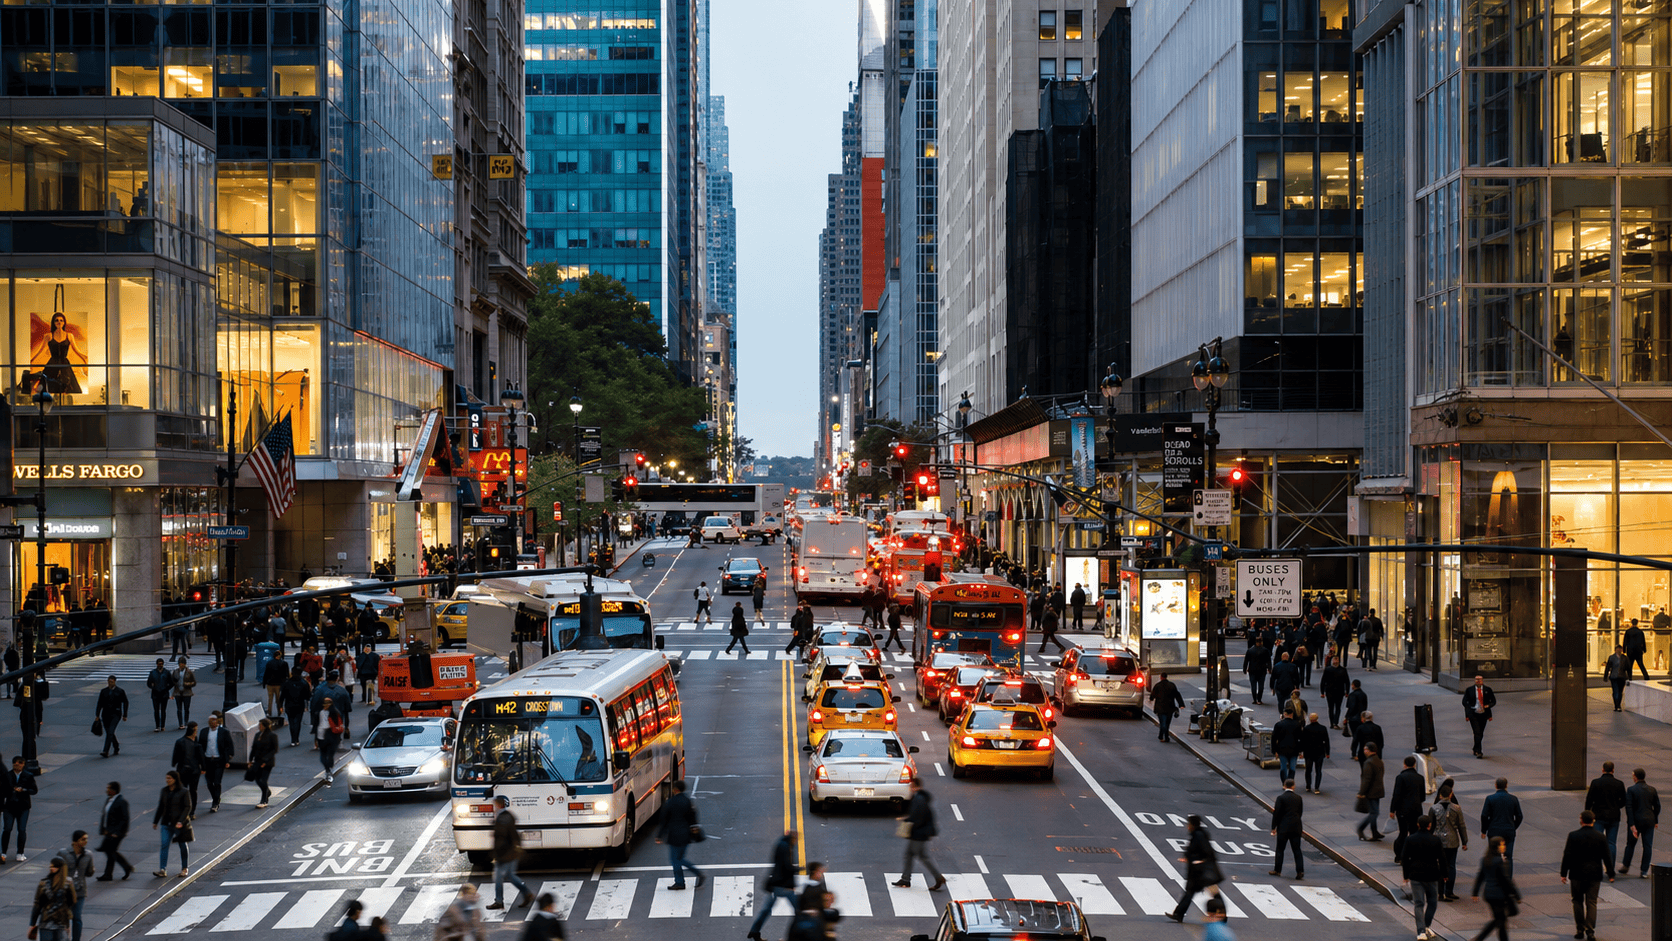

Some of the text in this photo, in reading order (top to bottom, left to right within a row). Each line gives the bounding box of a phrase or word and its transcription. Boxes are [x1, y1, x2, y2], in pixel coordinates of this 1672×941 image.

[78, 464, 144, 479] FARGO
[1248, 564, 1289, 575] BUSES
[1252, 577, 1286, 587] ONLY
[1134, 812, 1264, 831] ONLY
[1165, 838, 1276, 857] BUS
